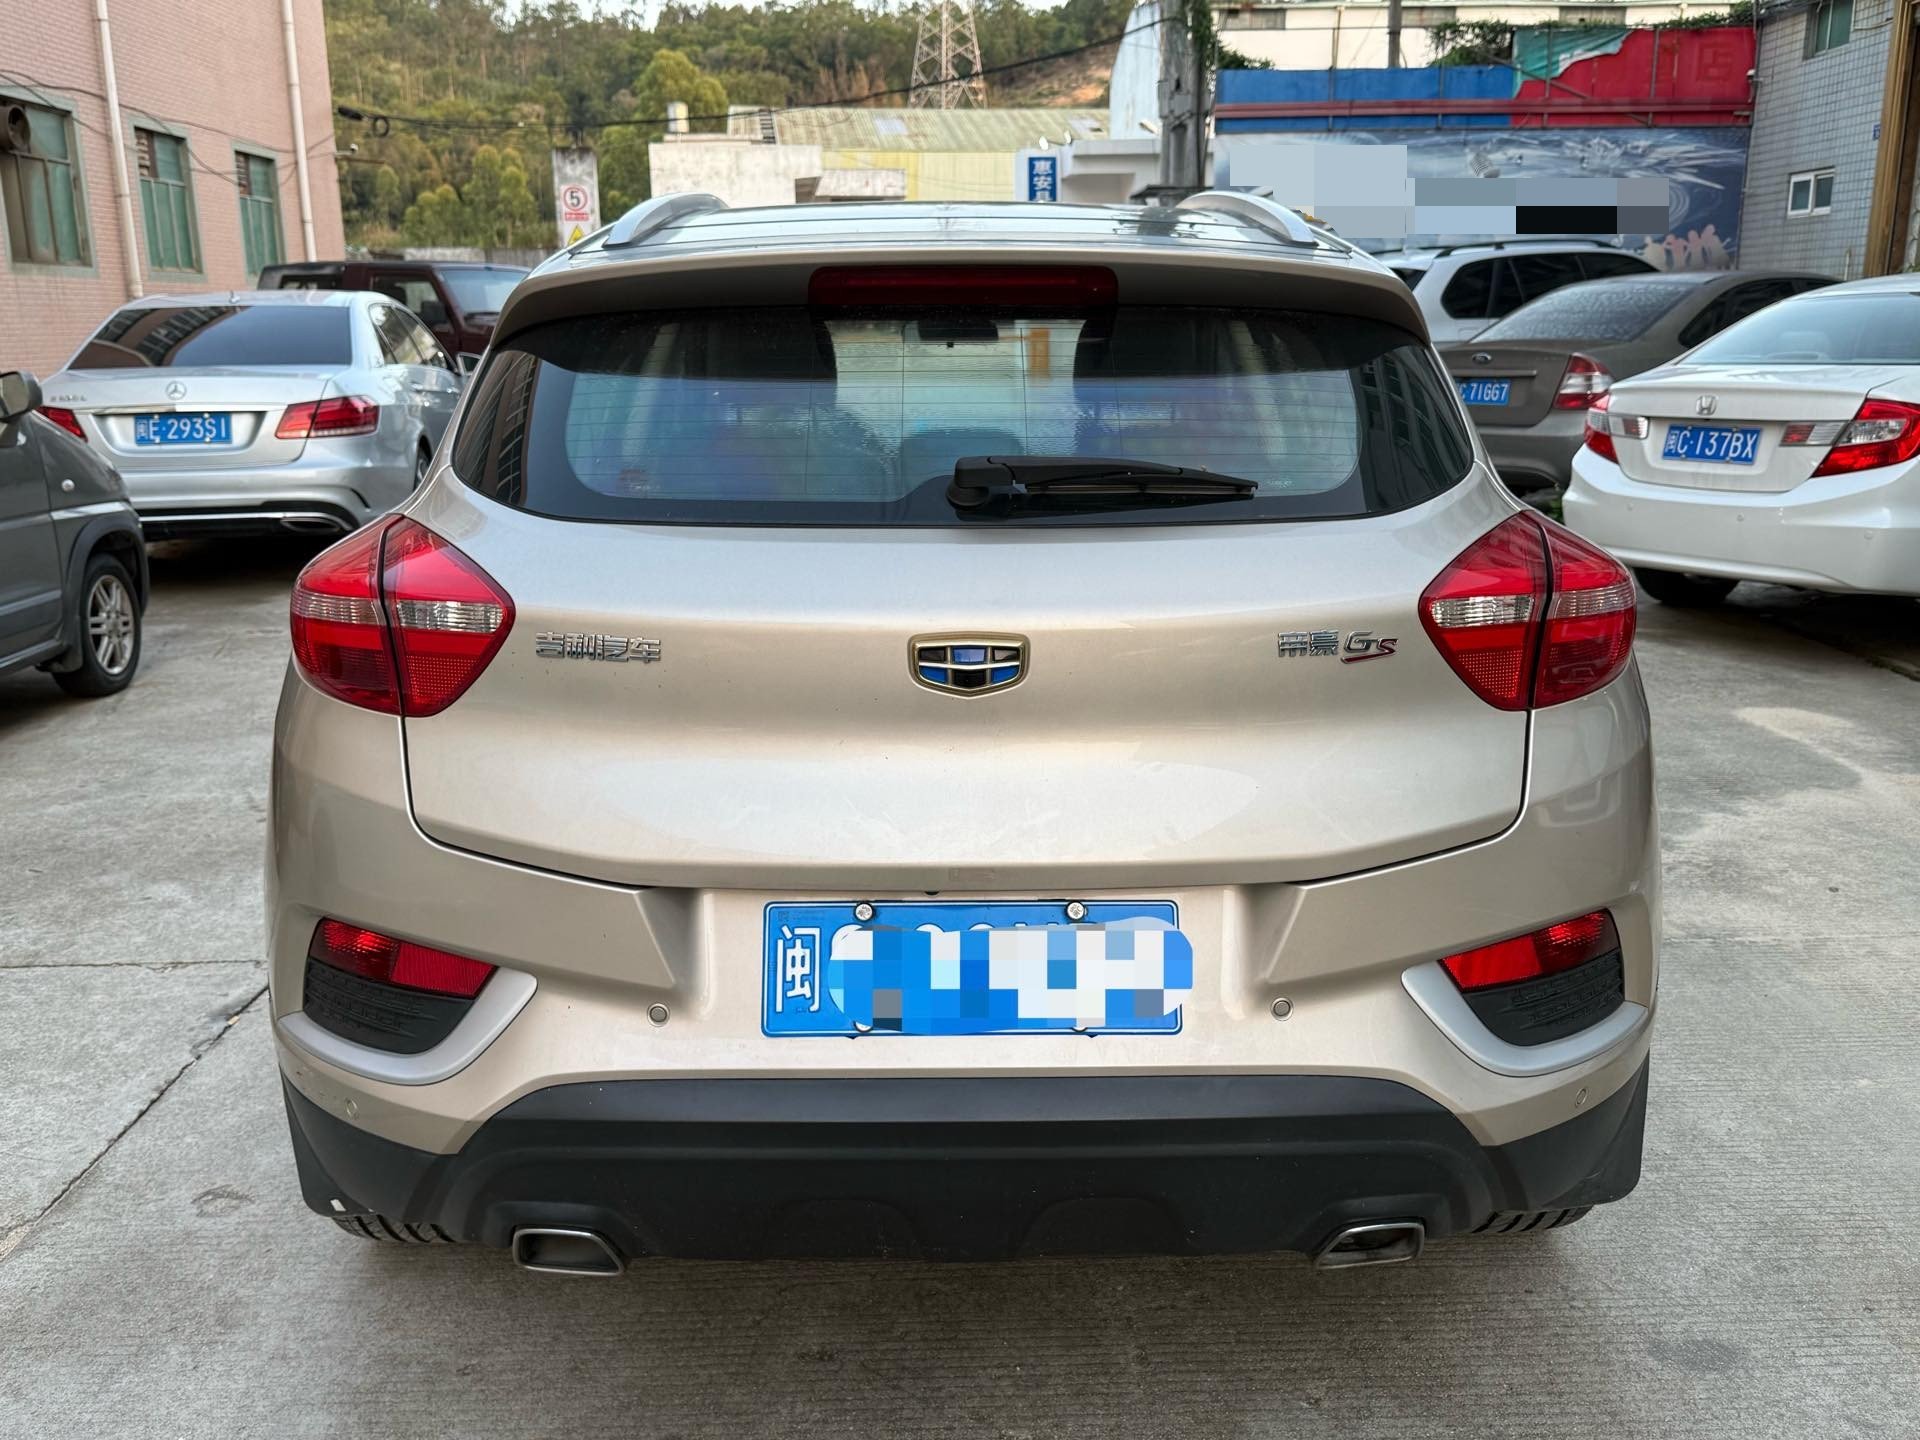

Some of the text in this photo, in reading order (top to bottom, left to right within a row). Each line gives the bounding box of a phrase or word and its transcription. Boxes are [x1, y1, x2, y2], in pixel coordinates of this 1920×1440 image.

[1664, 430, 1757, 459] 闽C·137BX
[535, 631, 661, 664] 吉利汽车
[1278, 629, 1339, 657] 帝豪
